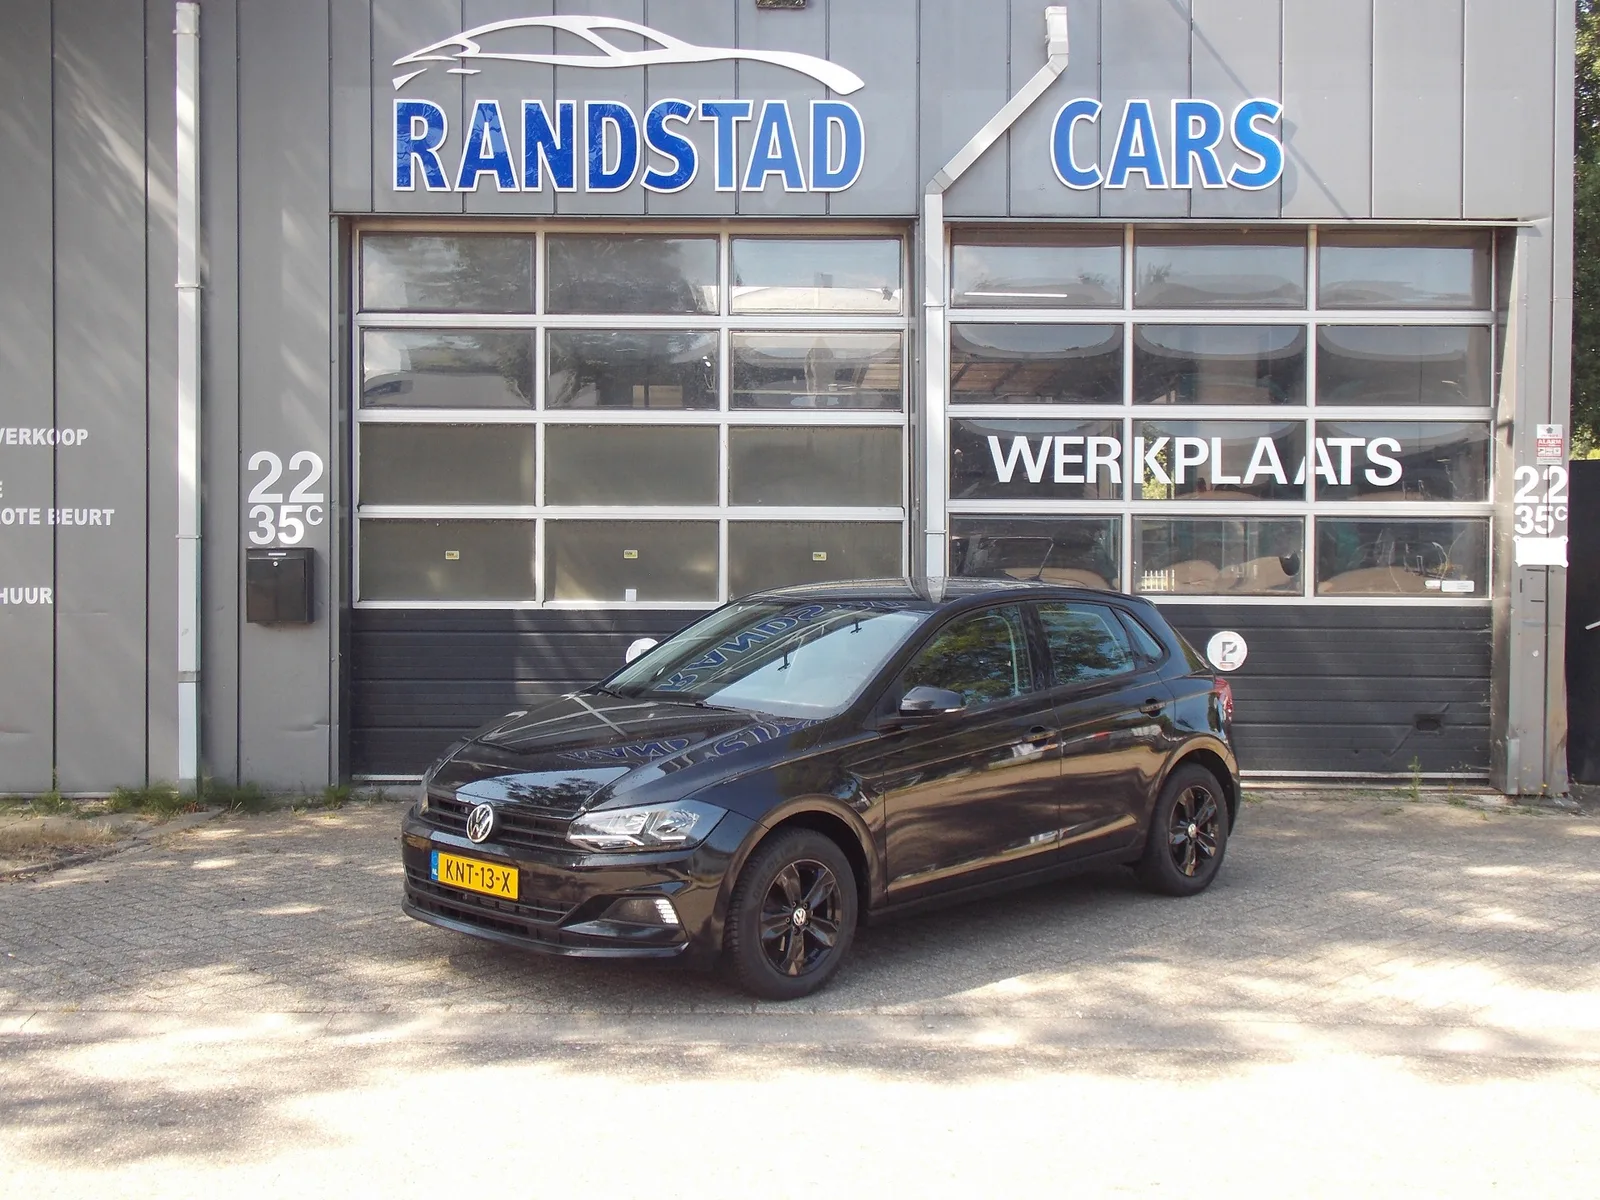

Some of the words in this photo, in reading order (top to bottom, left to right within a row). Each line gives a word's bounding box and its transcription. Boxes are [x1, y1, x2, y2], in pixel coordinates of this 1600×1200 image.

[393, 99, 865, 193] RANDSTAD
[1050, 97, 1285, 191] CARS
[248, 451, 324, 503] 22
[987, 436, 1403, 487] WERKPLAATS
[1513, 465, 1568, 504] 22
[0, 508, 41, 525] OTE
[47, 508, 115, 526] BEURT
[446, 859, 511, 894] KNT-13-X
